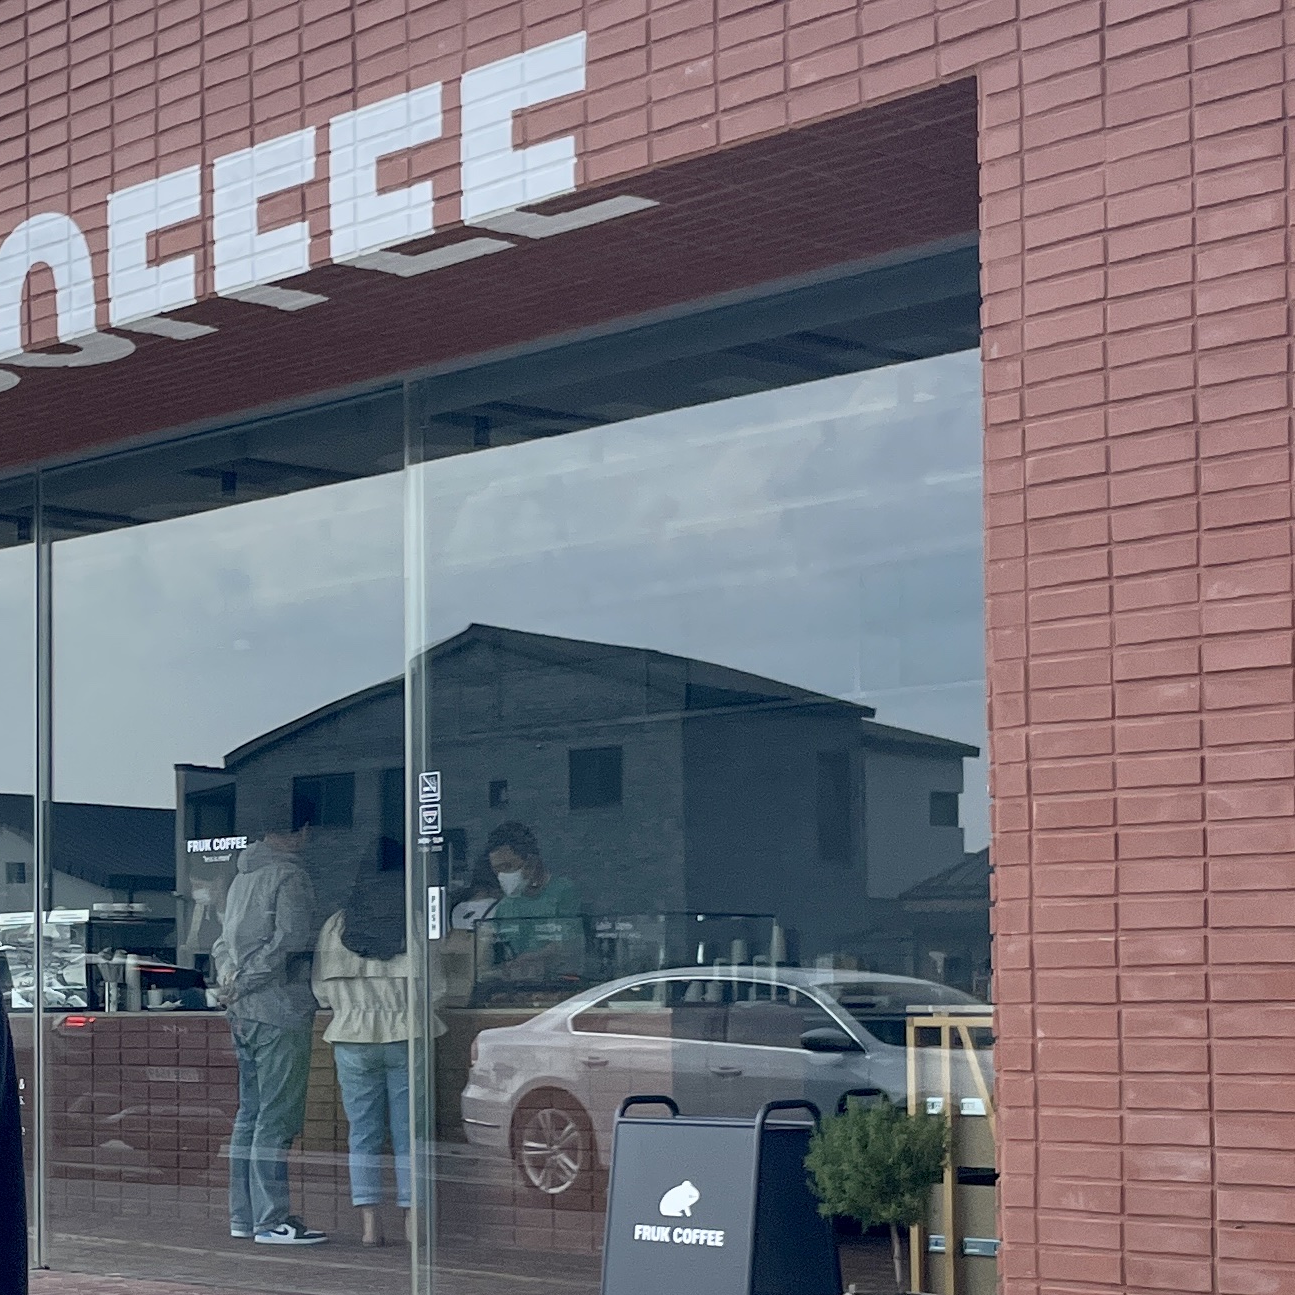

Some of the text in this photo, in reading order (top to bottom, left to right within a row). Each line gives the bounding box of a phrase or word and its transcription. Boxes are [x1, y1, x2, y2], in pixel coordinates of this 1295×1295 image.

[187, 836, 247, 853] FRUK COFFEE
[634, 1224, 724, 1247] FRUK COFFEE
